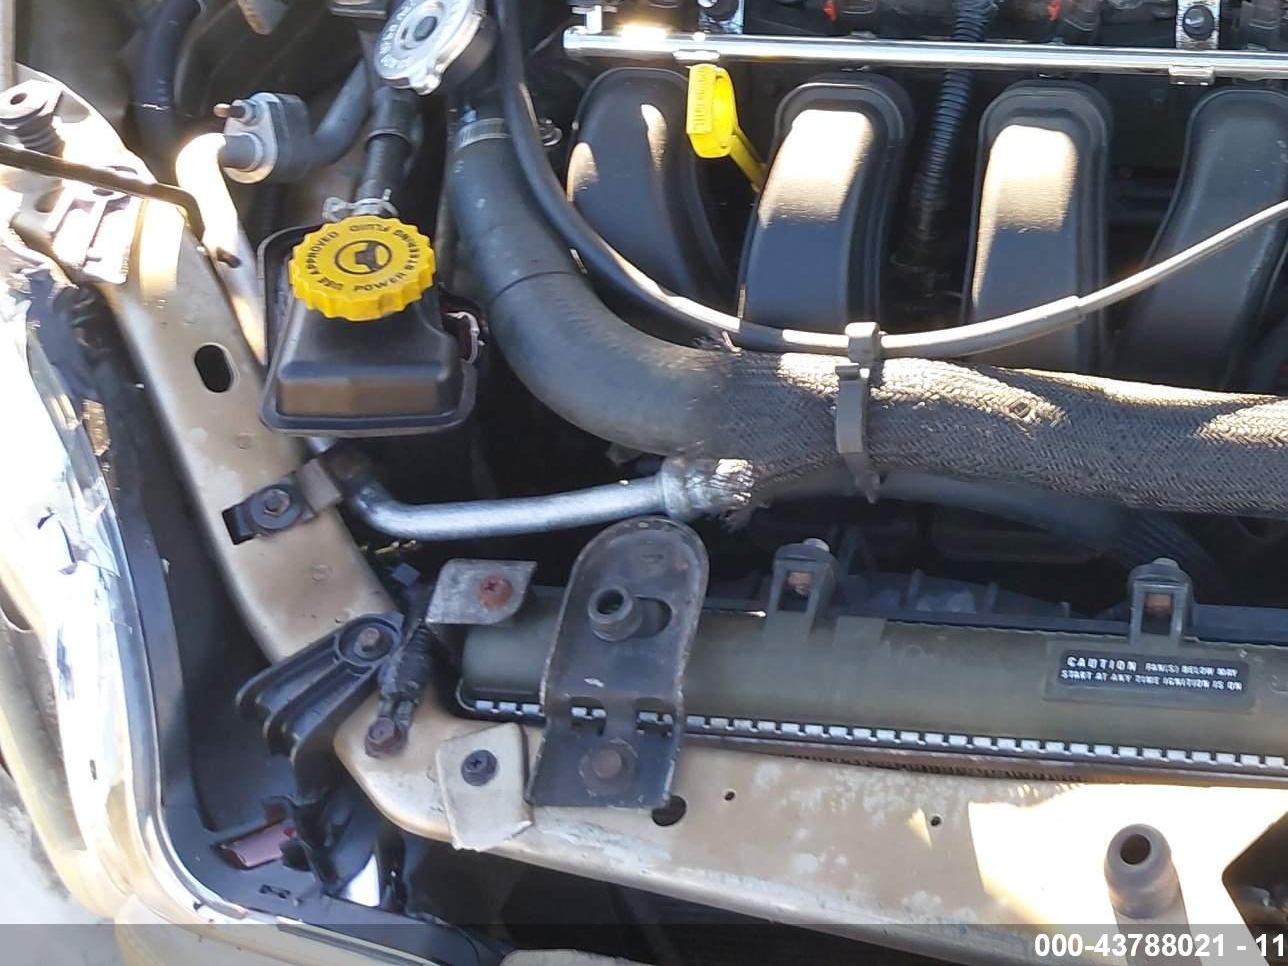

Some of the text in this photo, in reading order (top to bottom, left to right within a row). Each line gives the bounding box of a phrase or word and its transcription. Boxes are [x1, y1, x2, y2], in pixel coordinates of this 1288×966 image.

[354, 272, 406, 293] POWER
[1067, 656, 1137, 672] CAUTION
[1060, 669, 1092, 681] START
[1094, 672, 1108, 682] AT
[1110, 673, 1132, 683] ANY
[1163, 676, 1210, 689] IGNITION
[1212, 680, 1225, 690] IS
[1227, 681, 1243, 691] ON
